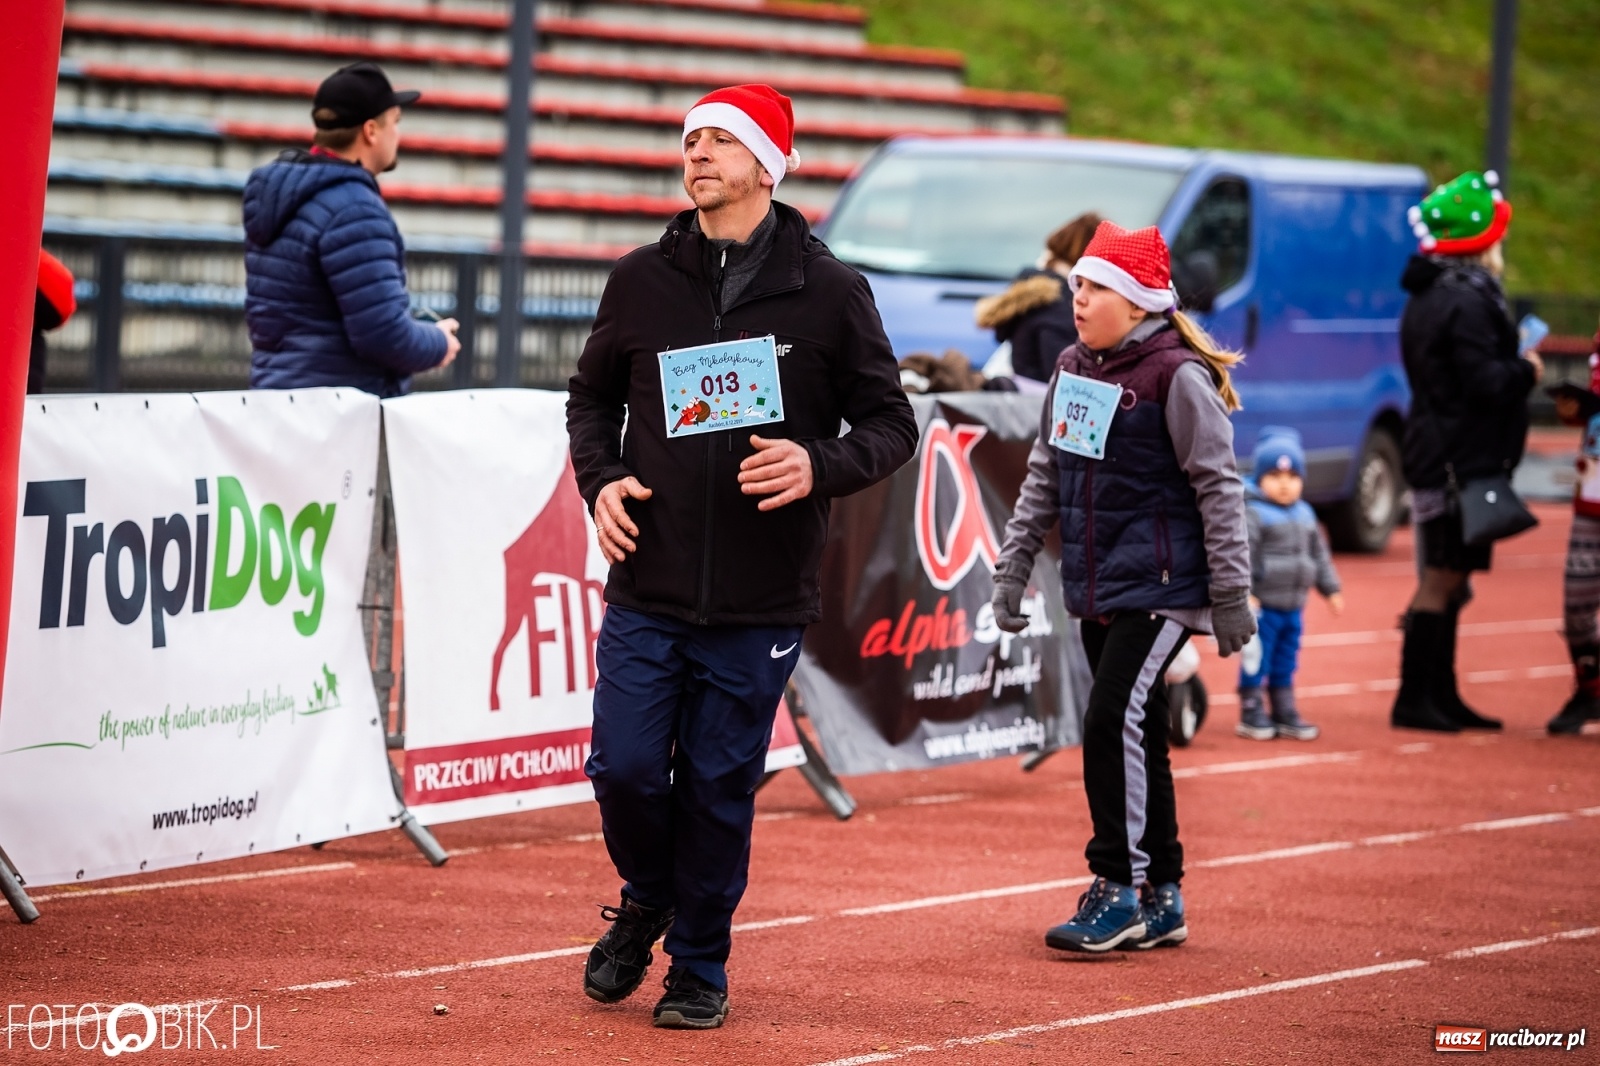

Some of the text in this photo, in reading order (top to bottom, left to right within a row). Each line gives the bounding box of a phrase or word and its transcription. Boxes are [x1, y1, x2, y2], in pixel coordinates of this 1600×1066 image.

[701, 371, 740, 396] 013
[1066, 401, 1089, 424] 037
[23, 476, 337, 649] TropiDog
[860, 596, 973, 671] alpha
[914, 662, 954, 700] wild
[954, 654, 995, 696] and
[99, 710, 119, 741] the
[122, 716, 157, 752] power
[158, 703, 171, 740] of
[172, 703, 207, 731] nature
[209, 705, 219, 724] in
[220, 689, 262, 739] everyday
[413, 753, 499, 793] PRZECIW
[500, 744, 573, 781] PCHŁOM
[152, 790, 259, 830] www.tropidog.pl
